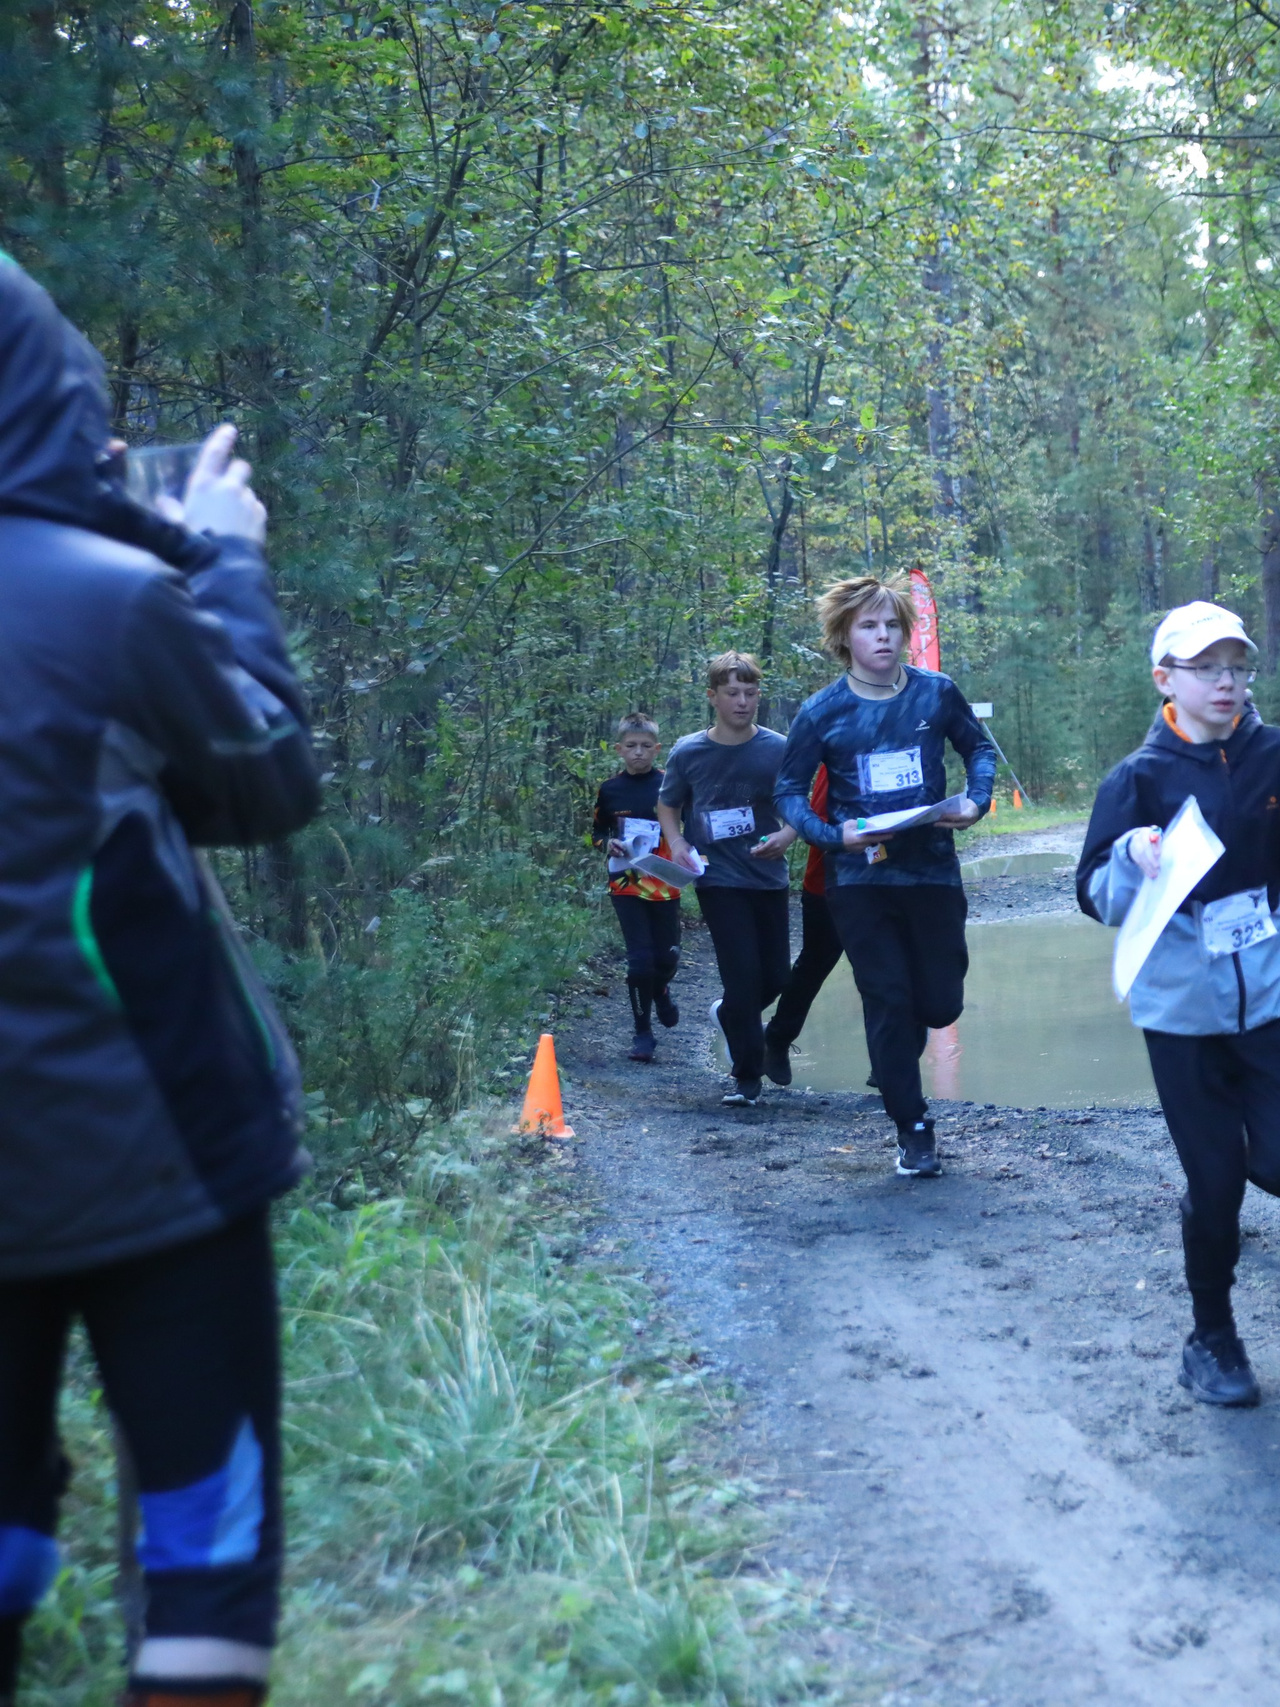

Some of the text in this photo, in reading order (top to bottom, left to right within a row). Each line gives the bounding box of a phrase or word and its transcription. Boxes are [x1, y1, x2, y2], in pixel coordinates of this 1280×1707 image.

[896, 770, 921, 787] 313
[728, 823, 752, 836] 334
[1232, 919, 1266, 948] 323
